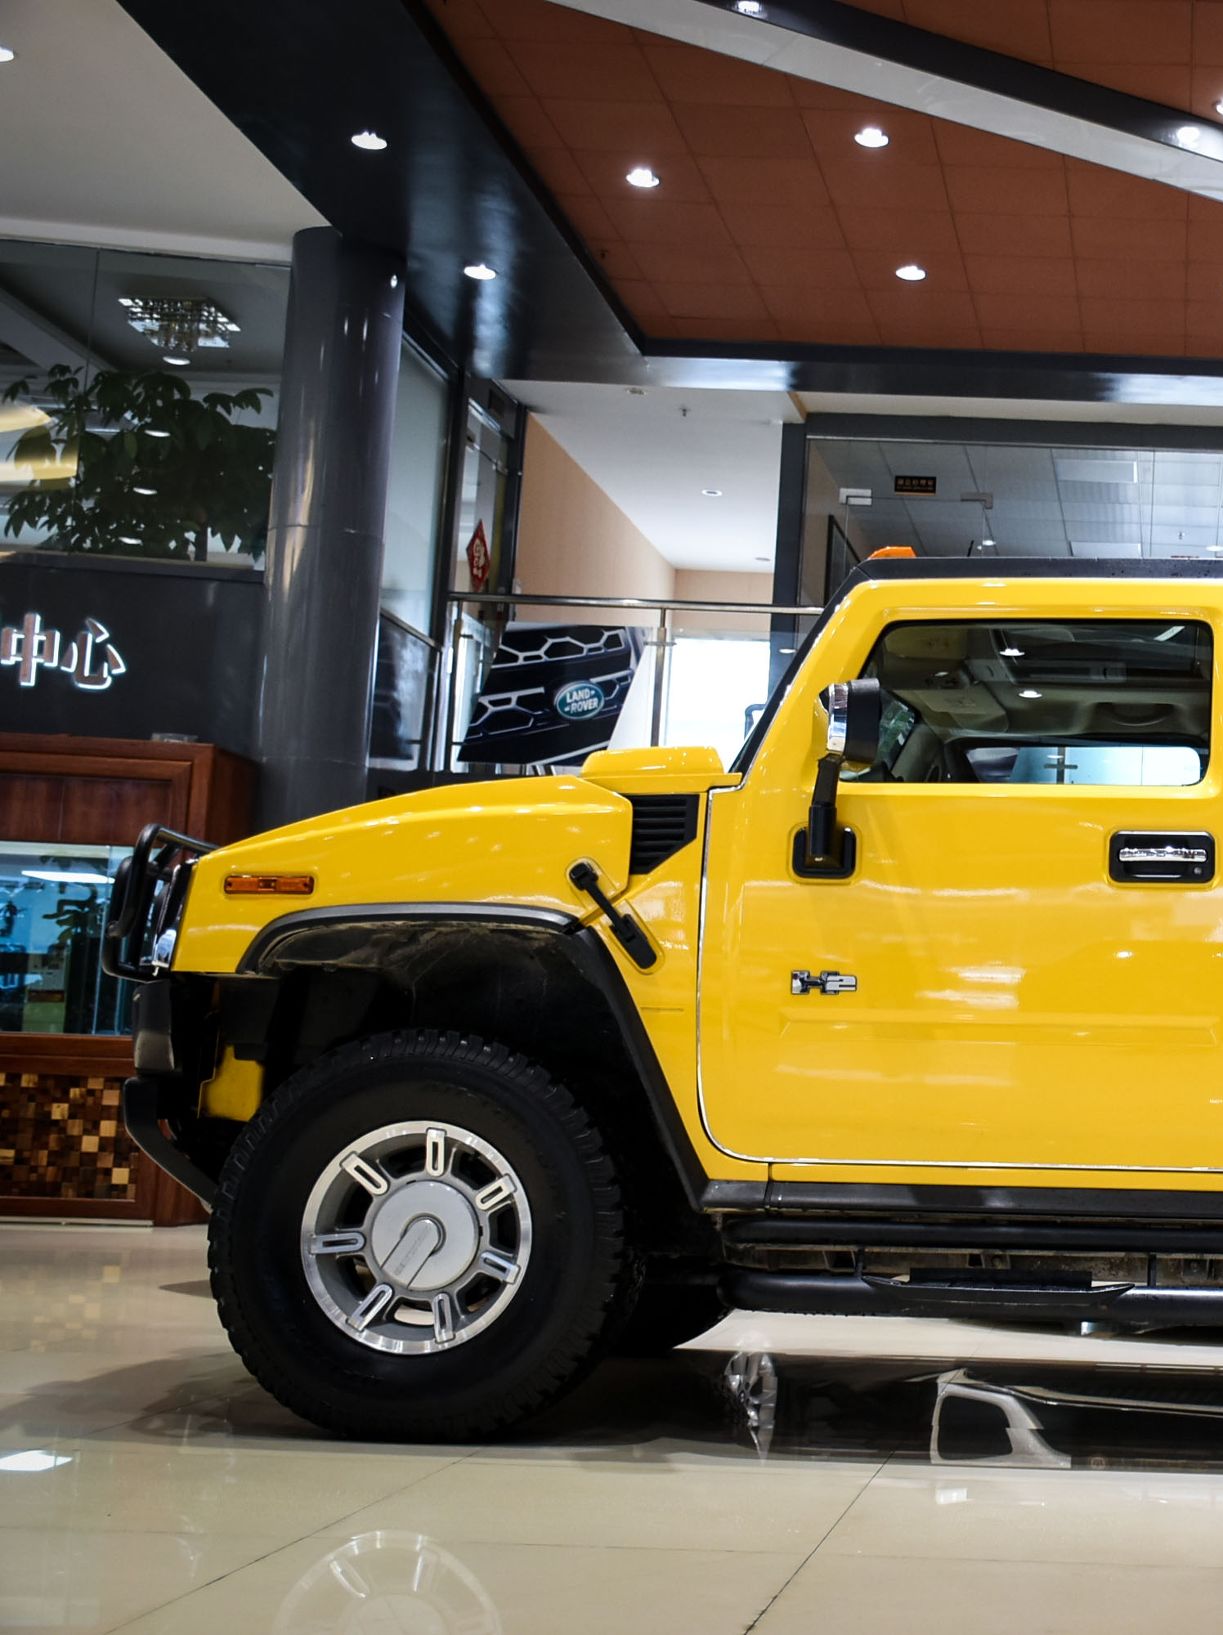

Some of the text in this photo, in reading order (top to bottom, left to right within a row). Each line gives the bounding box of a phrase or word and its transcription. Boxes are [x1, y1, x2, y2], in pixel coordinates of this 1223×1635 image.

[0, 612, 127, 690] 中心
[566, 688, 590, 703] LAND
[571, 697, 599, 714] ROVER
[791, 970, 857, 995] H2
